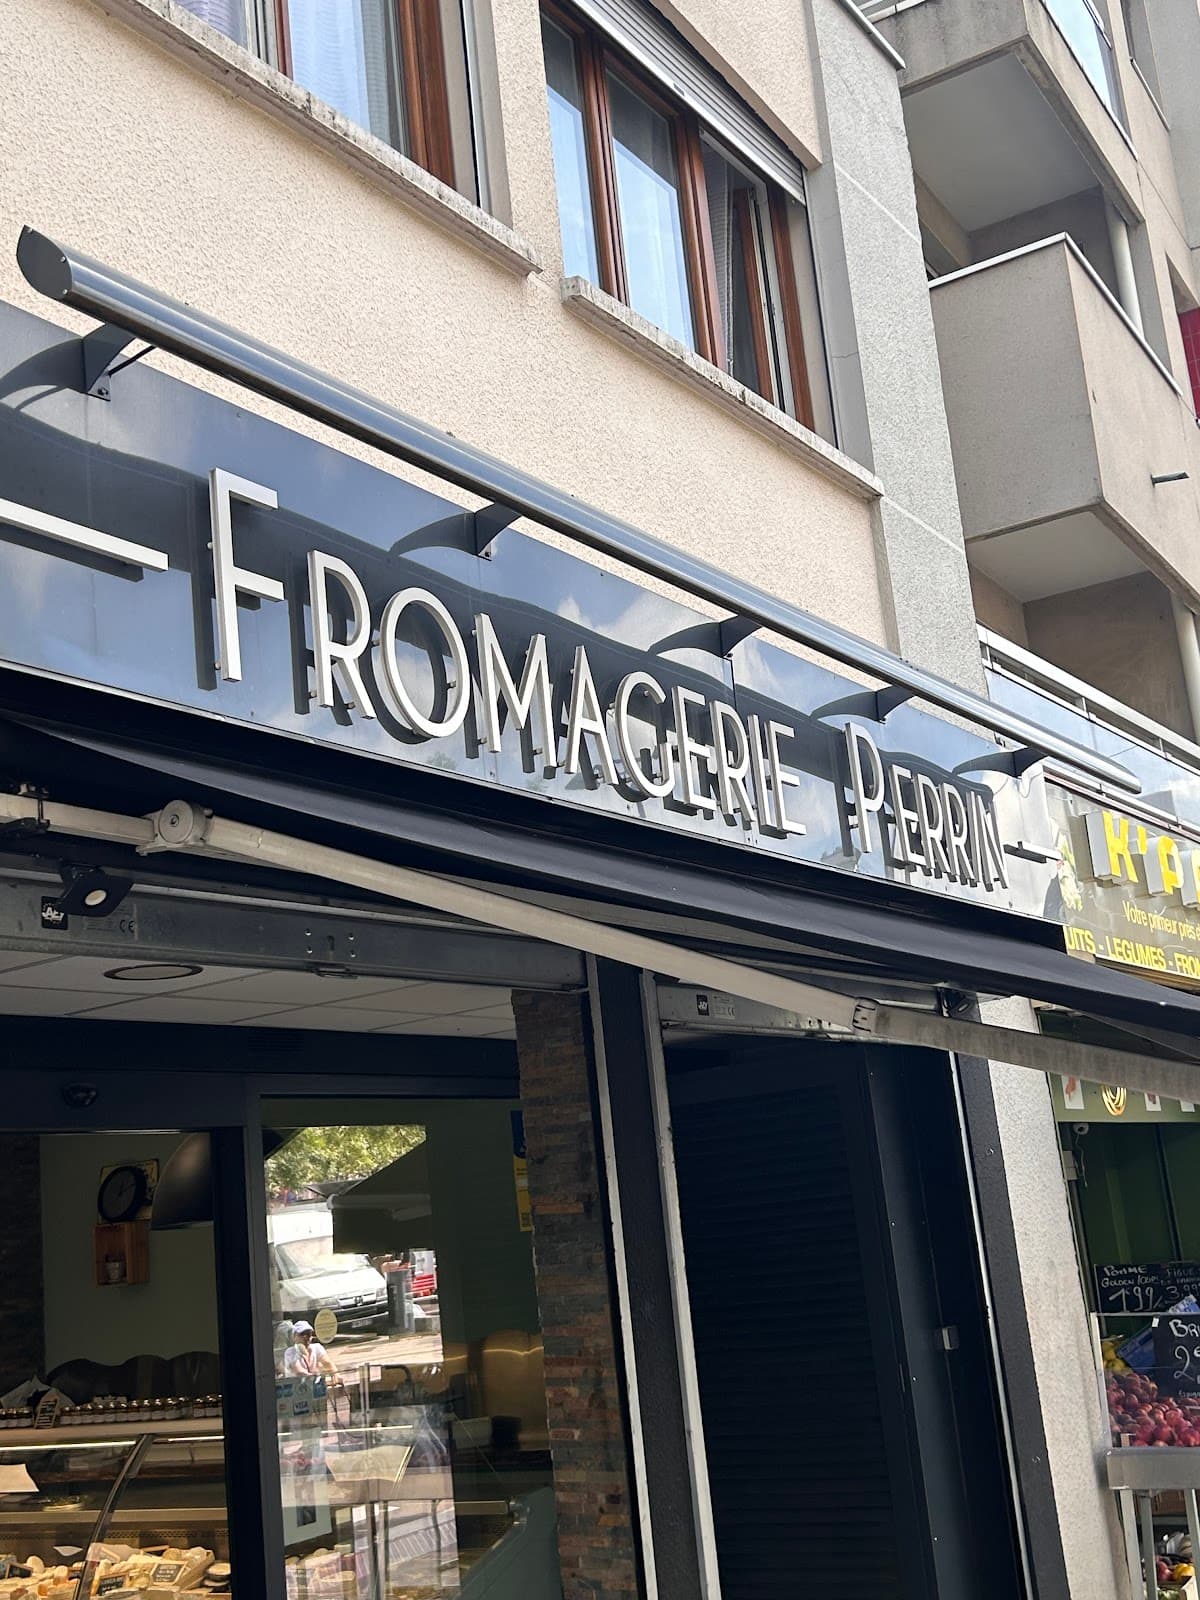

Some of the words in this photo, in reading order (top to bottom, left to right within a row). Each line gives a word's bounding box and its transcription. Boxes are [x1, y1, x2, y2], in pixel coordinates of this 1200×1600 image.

[210, 467, 806, 836] FROMAGERIE
[844, 721, 1009, 889] PERRIN
[1122, 900, 1148, 926] Votre
